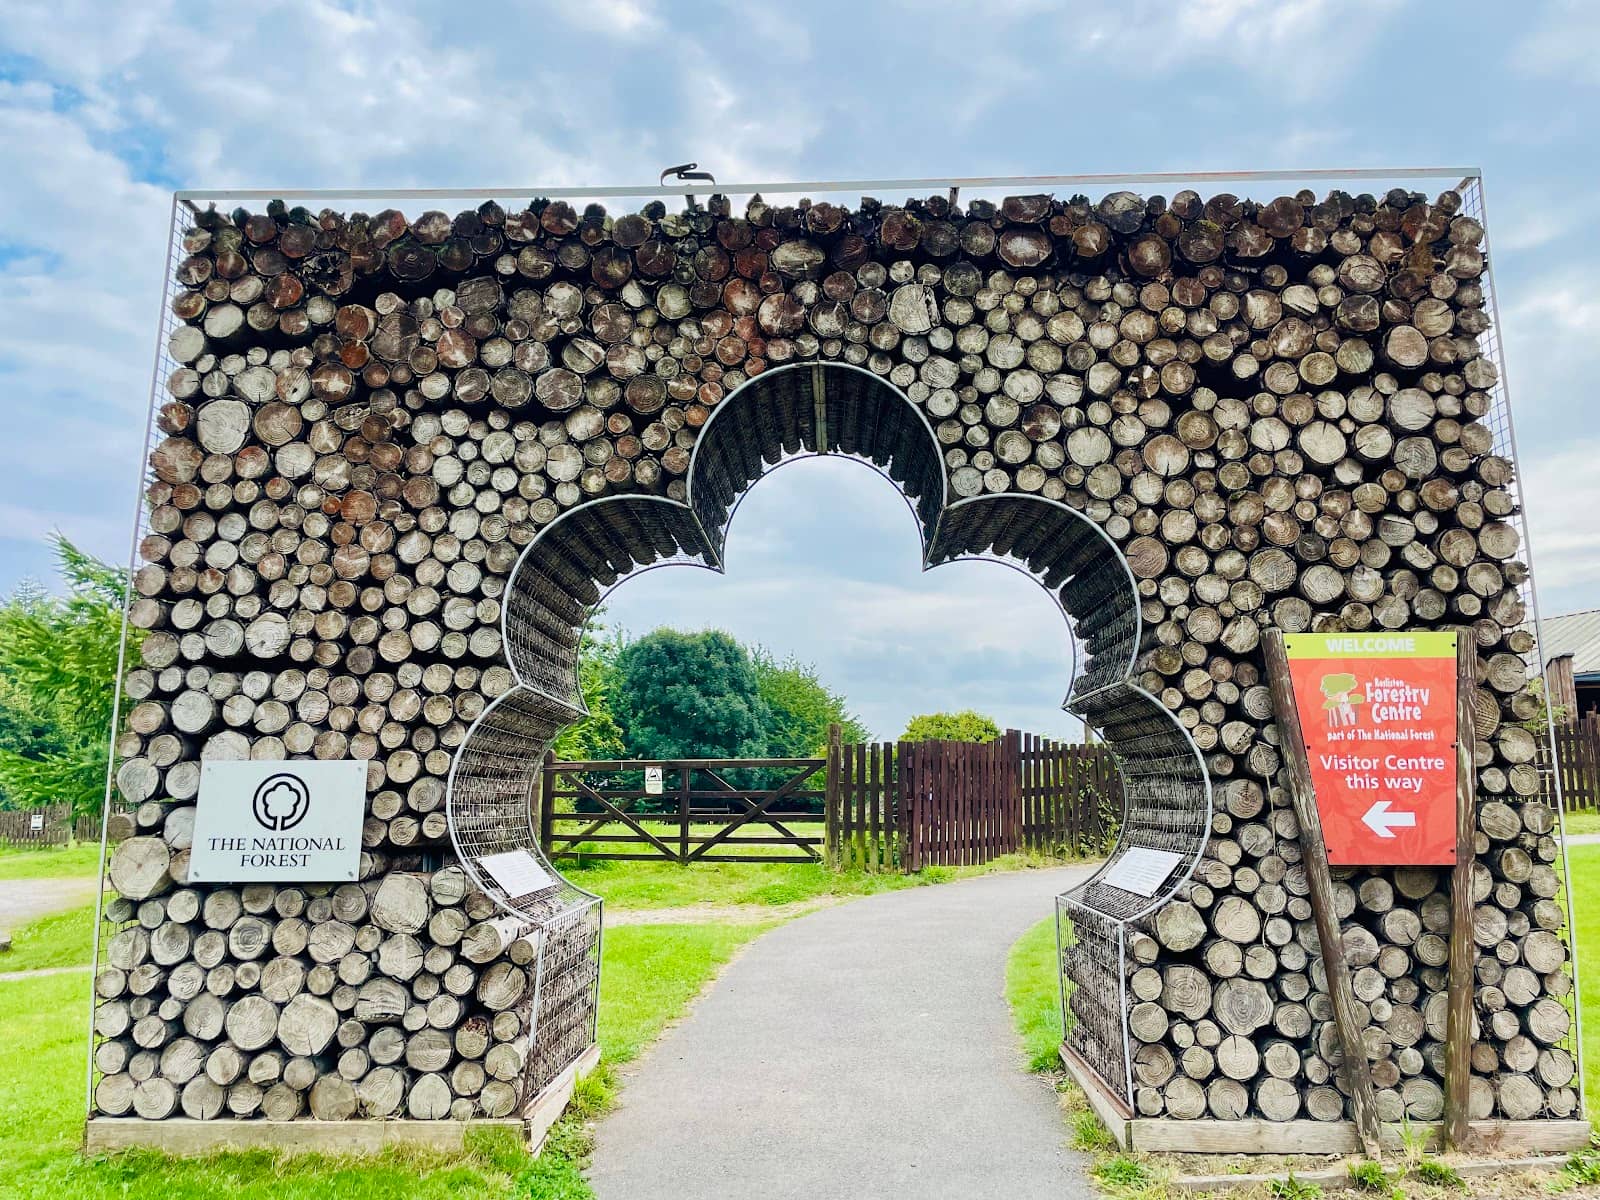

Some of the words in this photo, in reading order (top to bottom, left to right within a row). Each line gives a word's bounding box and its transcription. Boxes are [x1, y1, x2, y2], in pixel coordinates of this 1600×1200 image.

[1326, 638, 1415, 652] WELCOME
[1365, 683, 1430, 706] Forestry
[1371, 702, 1421, 723] Centre
[1327, 731, 1345, 742] part
[1346, 728, 1356, 740] of
[1357, 728, 1372, 740] The
[1374, 728, 1409, 740] National
[1410, 728, 1435, 740] Forest
[1320, 755, 1378, 770] Visitor
[1385, 755, 1444, 770] Centre
[1345, 773, 1379, 789] this
[1384, 778, 1422, 792] way
[208, 837, 246, 850] THE
[252, 837, 345, 850] NATIONAL
[240, 854, 311, 867] FOREST
